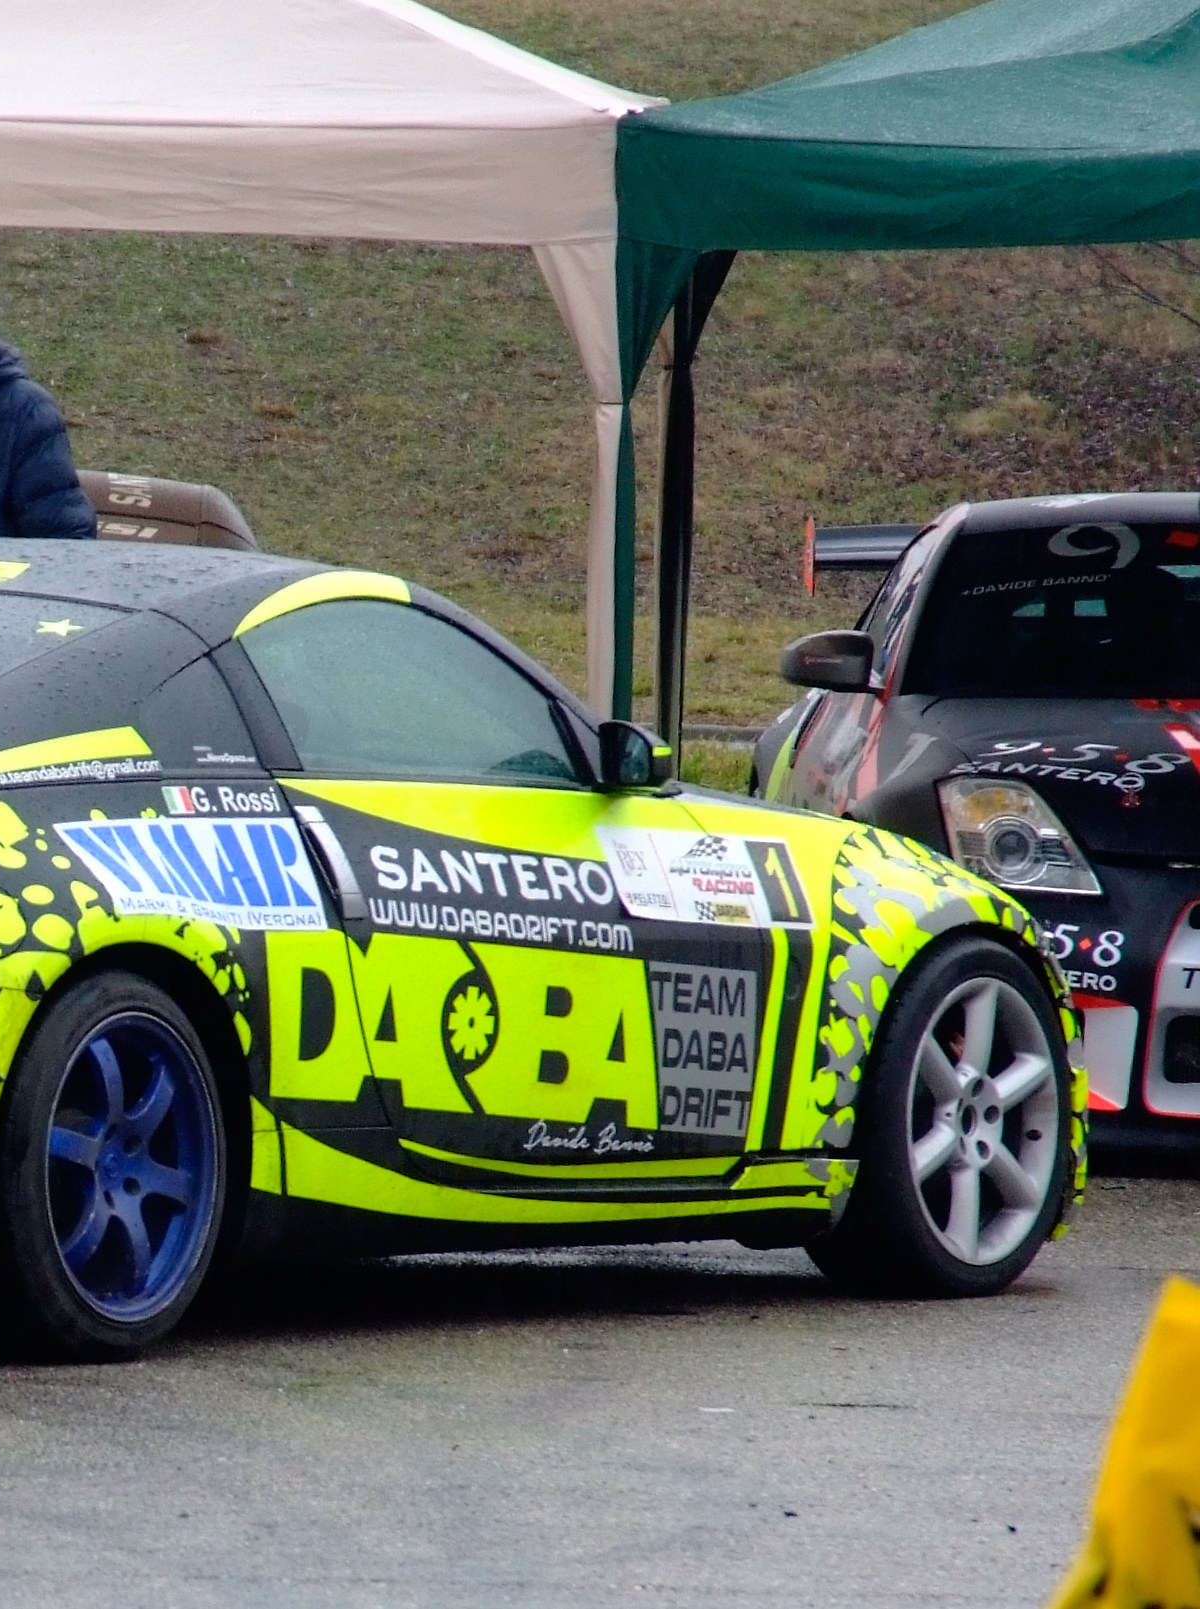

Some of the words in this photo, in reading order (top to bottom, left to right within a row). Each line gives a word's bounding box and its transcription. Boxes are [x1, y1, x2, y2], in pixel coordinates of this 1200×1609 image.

[192, 787, 217, 812] G.
[218, 786, 281, 813] Rossi
[370, 845, 614, 905] SANTERO
[691, 878, 755, 896] RACING
[764, 847, 799, 918] 1
[653, 969, 746, 1017] TEAM
[662, 1027, 748, 1074] DABA
[661, 1082, 753, 1132] DRIFT
